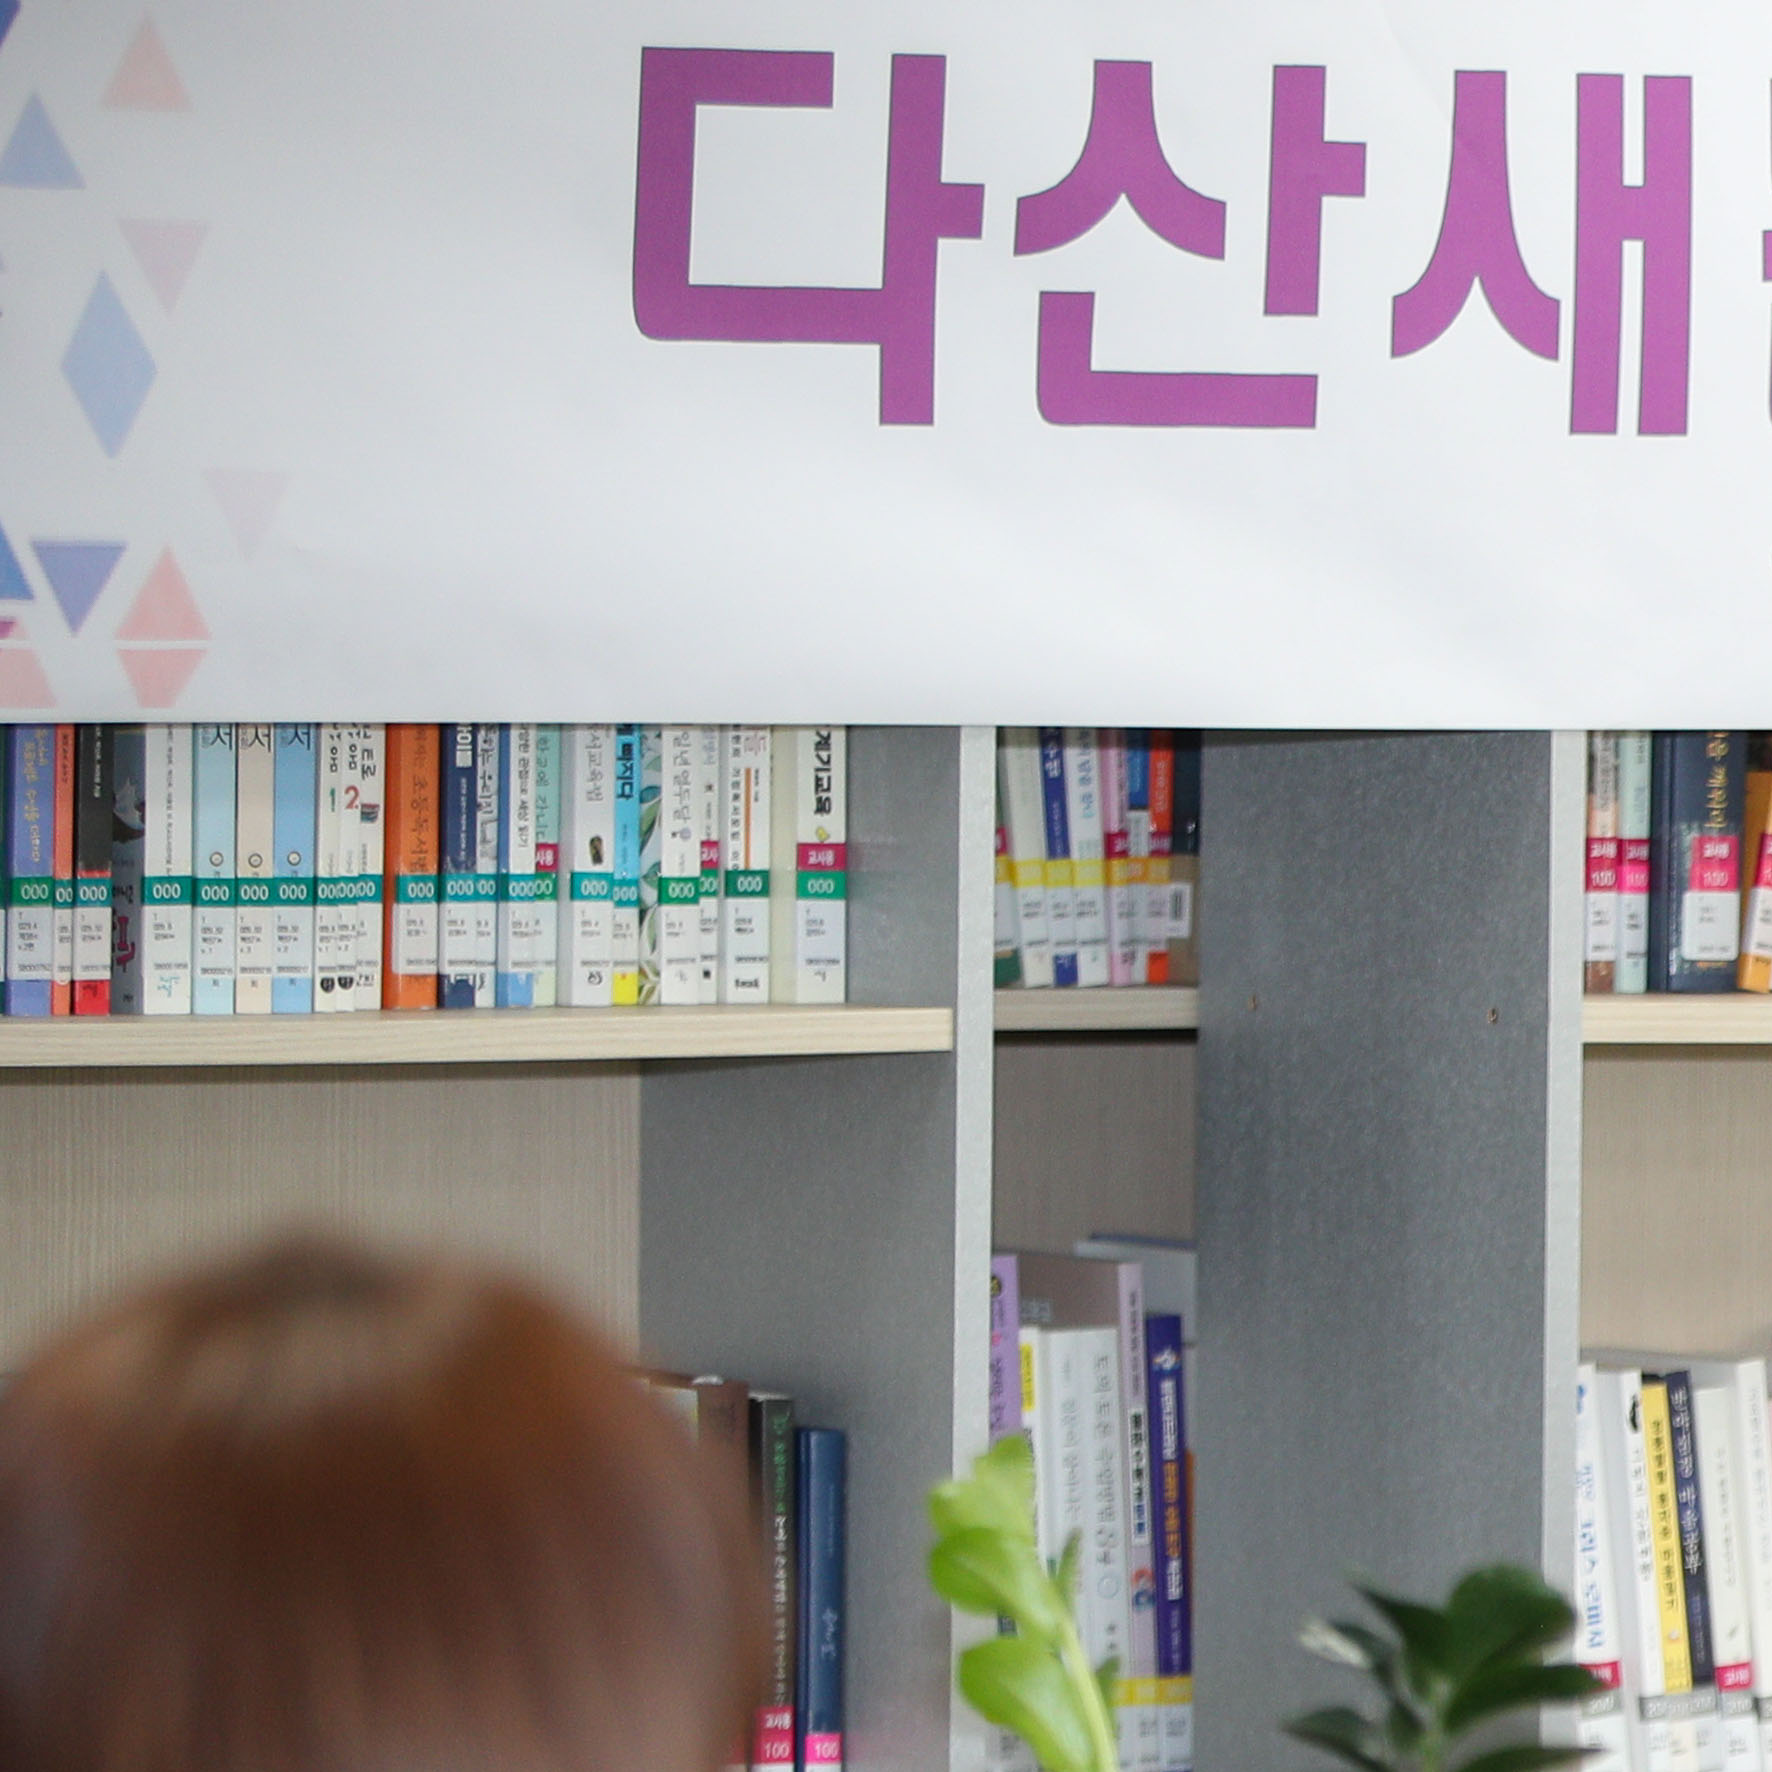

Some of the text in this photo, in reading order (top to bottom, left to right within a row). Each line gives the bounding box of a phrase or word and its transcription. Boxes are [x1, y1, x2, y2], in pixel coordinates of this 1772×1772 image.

[616, 742, 634, 802] 빠지다
[764, 1743, 790, 1758] 100
[814, 1744, 840, 1758] 100
